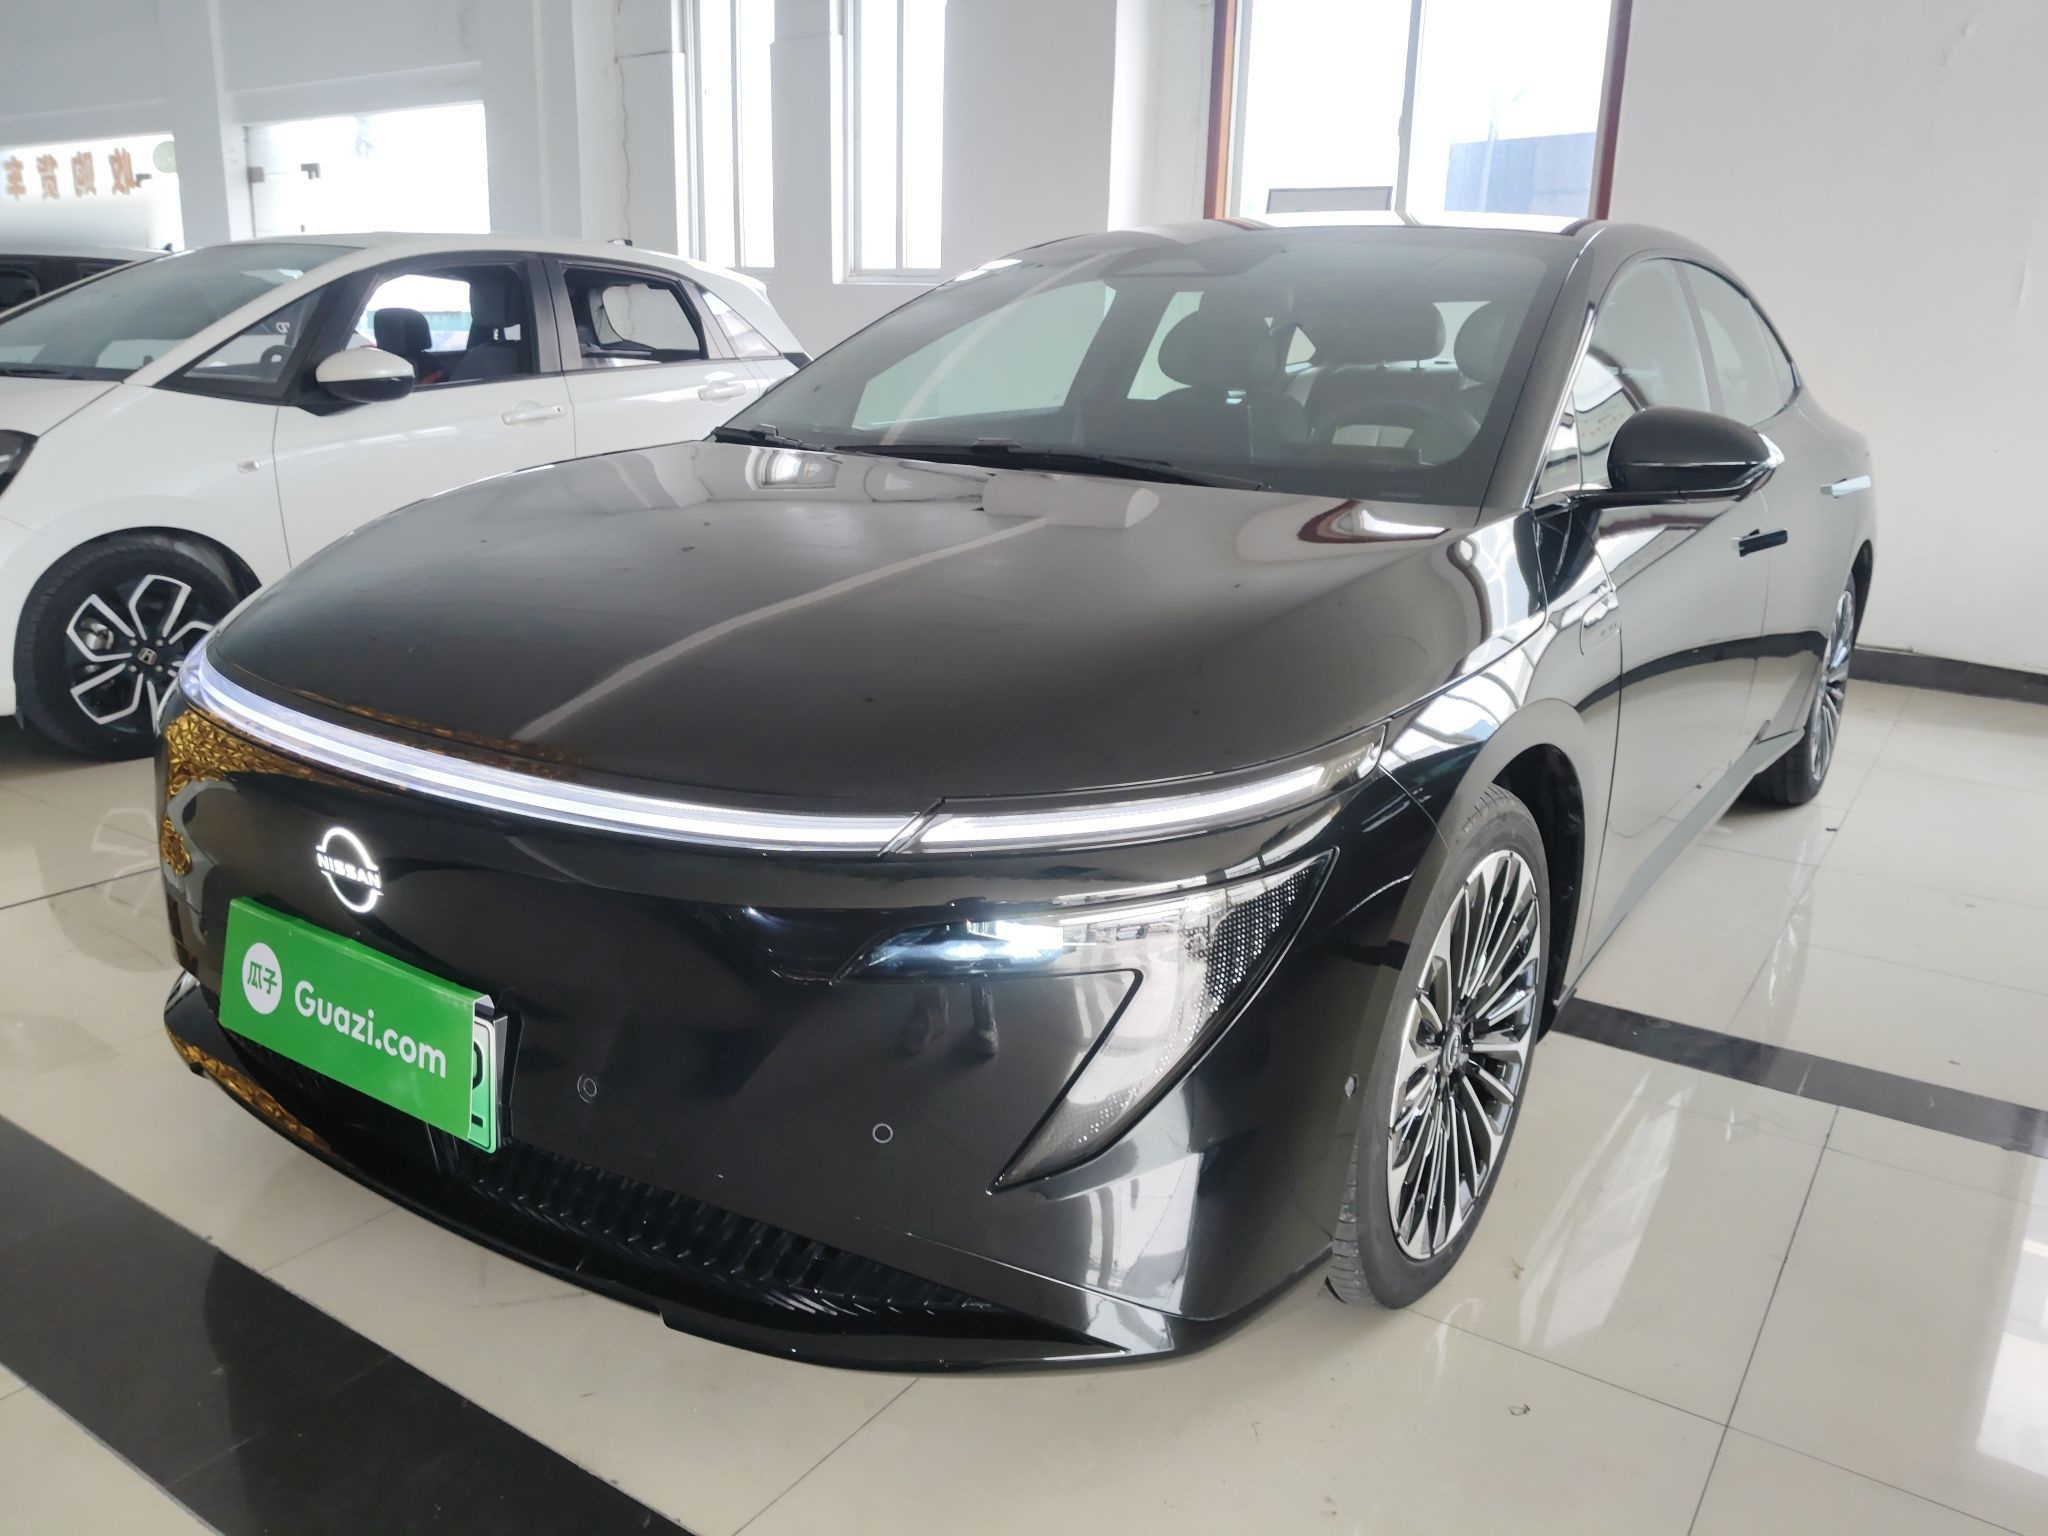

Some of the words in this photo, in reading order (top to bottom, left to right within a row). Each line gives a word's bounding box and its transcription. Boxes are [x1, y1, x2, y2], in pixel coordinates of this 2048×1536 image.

[316, 852, 382, 889] NISSAN
[247, 961, 278, 995] 瓜子
[294, 980, 447, 1079] Guazi.com
